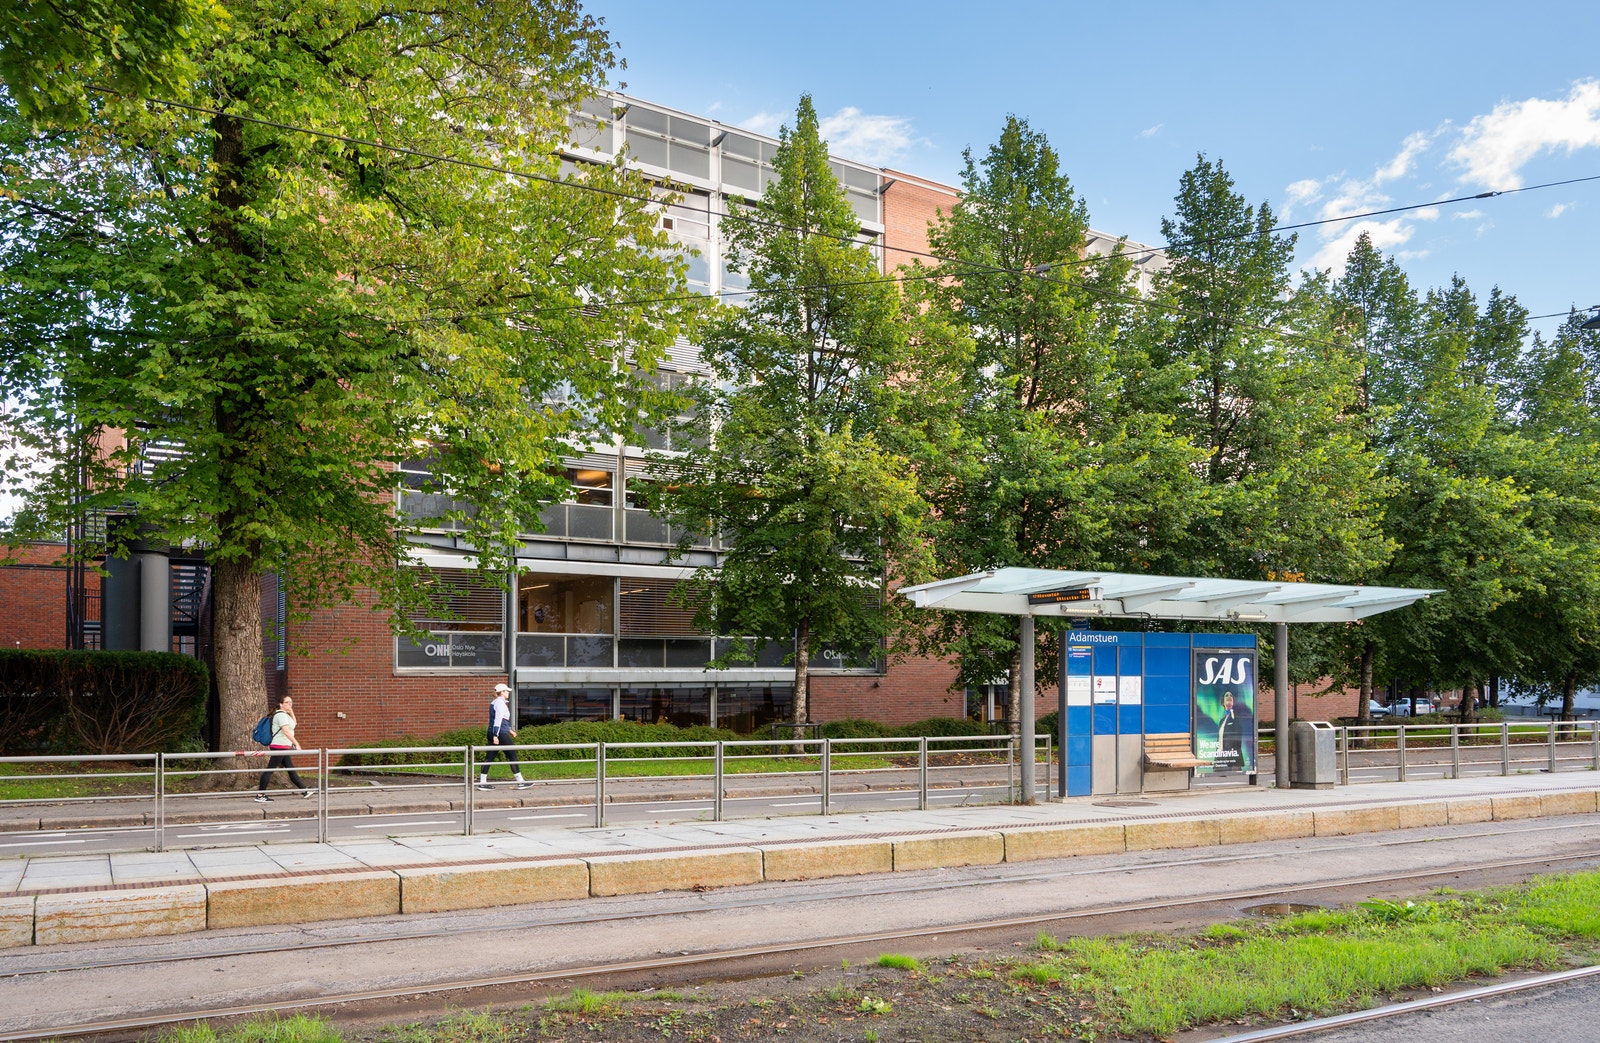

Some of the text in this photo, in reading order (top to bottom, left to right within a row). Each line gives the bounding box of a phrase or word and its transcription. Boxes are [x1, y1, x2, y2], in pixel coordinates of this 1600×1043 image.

[1069, 632, 1118, 642] Adamstuen
[425, 644, 449, 656] ONH
[1199, 657, 1250, 685] SAS
[1200, 740, 1220, 749] We are
[1199, 748, 1239, 758] Scandinavia.
